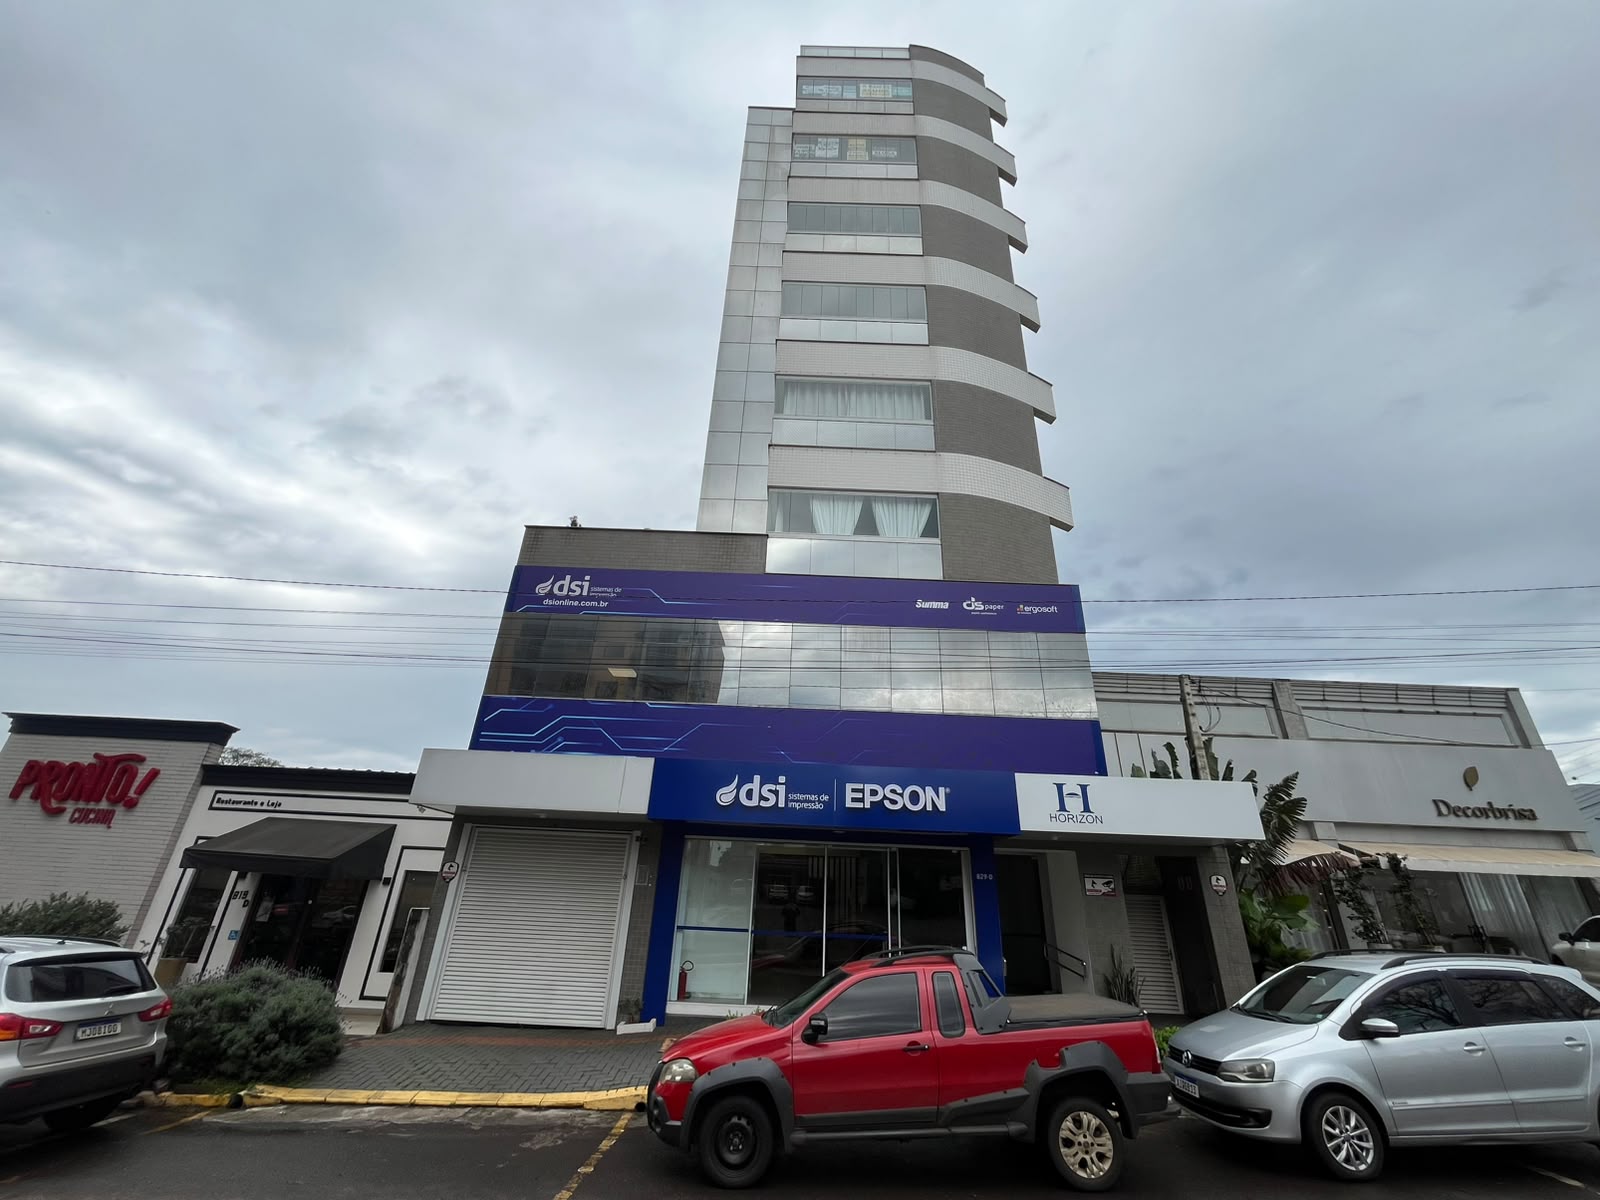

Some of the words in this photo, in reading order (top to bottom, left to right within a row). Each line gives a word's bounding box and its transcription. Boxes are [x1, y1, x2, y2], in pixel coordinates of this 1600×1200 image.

[552, 575, 591, 596] dsi
[543, 598, 609, 608] dsionline.com.br
[915, 599, 950, 610] Summa
[1024, 604, 1058, 614] ergosoft
[9, 752, 160, 814] PRONTO!
[738, 774, 786, 808] dsi
[788, 793, 817, 801] sistemas
[845, 782, 947, 812] EPSON
[215, 797, 258, 807] Restaurante
[266, 799, 282, 809] Loja
[788, 801, 824, 810] impressão
[1431, 798, 1538, 821] Decorbrisa
[1049, 813, 1104, 825] HORIZON
[231, 890, 249, 900] 819
